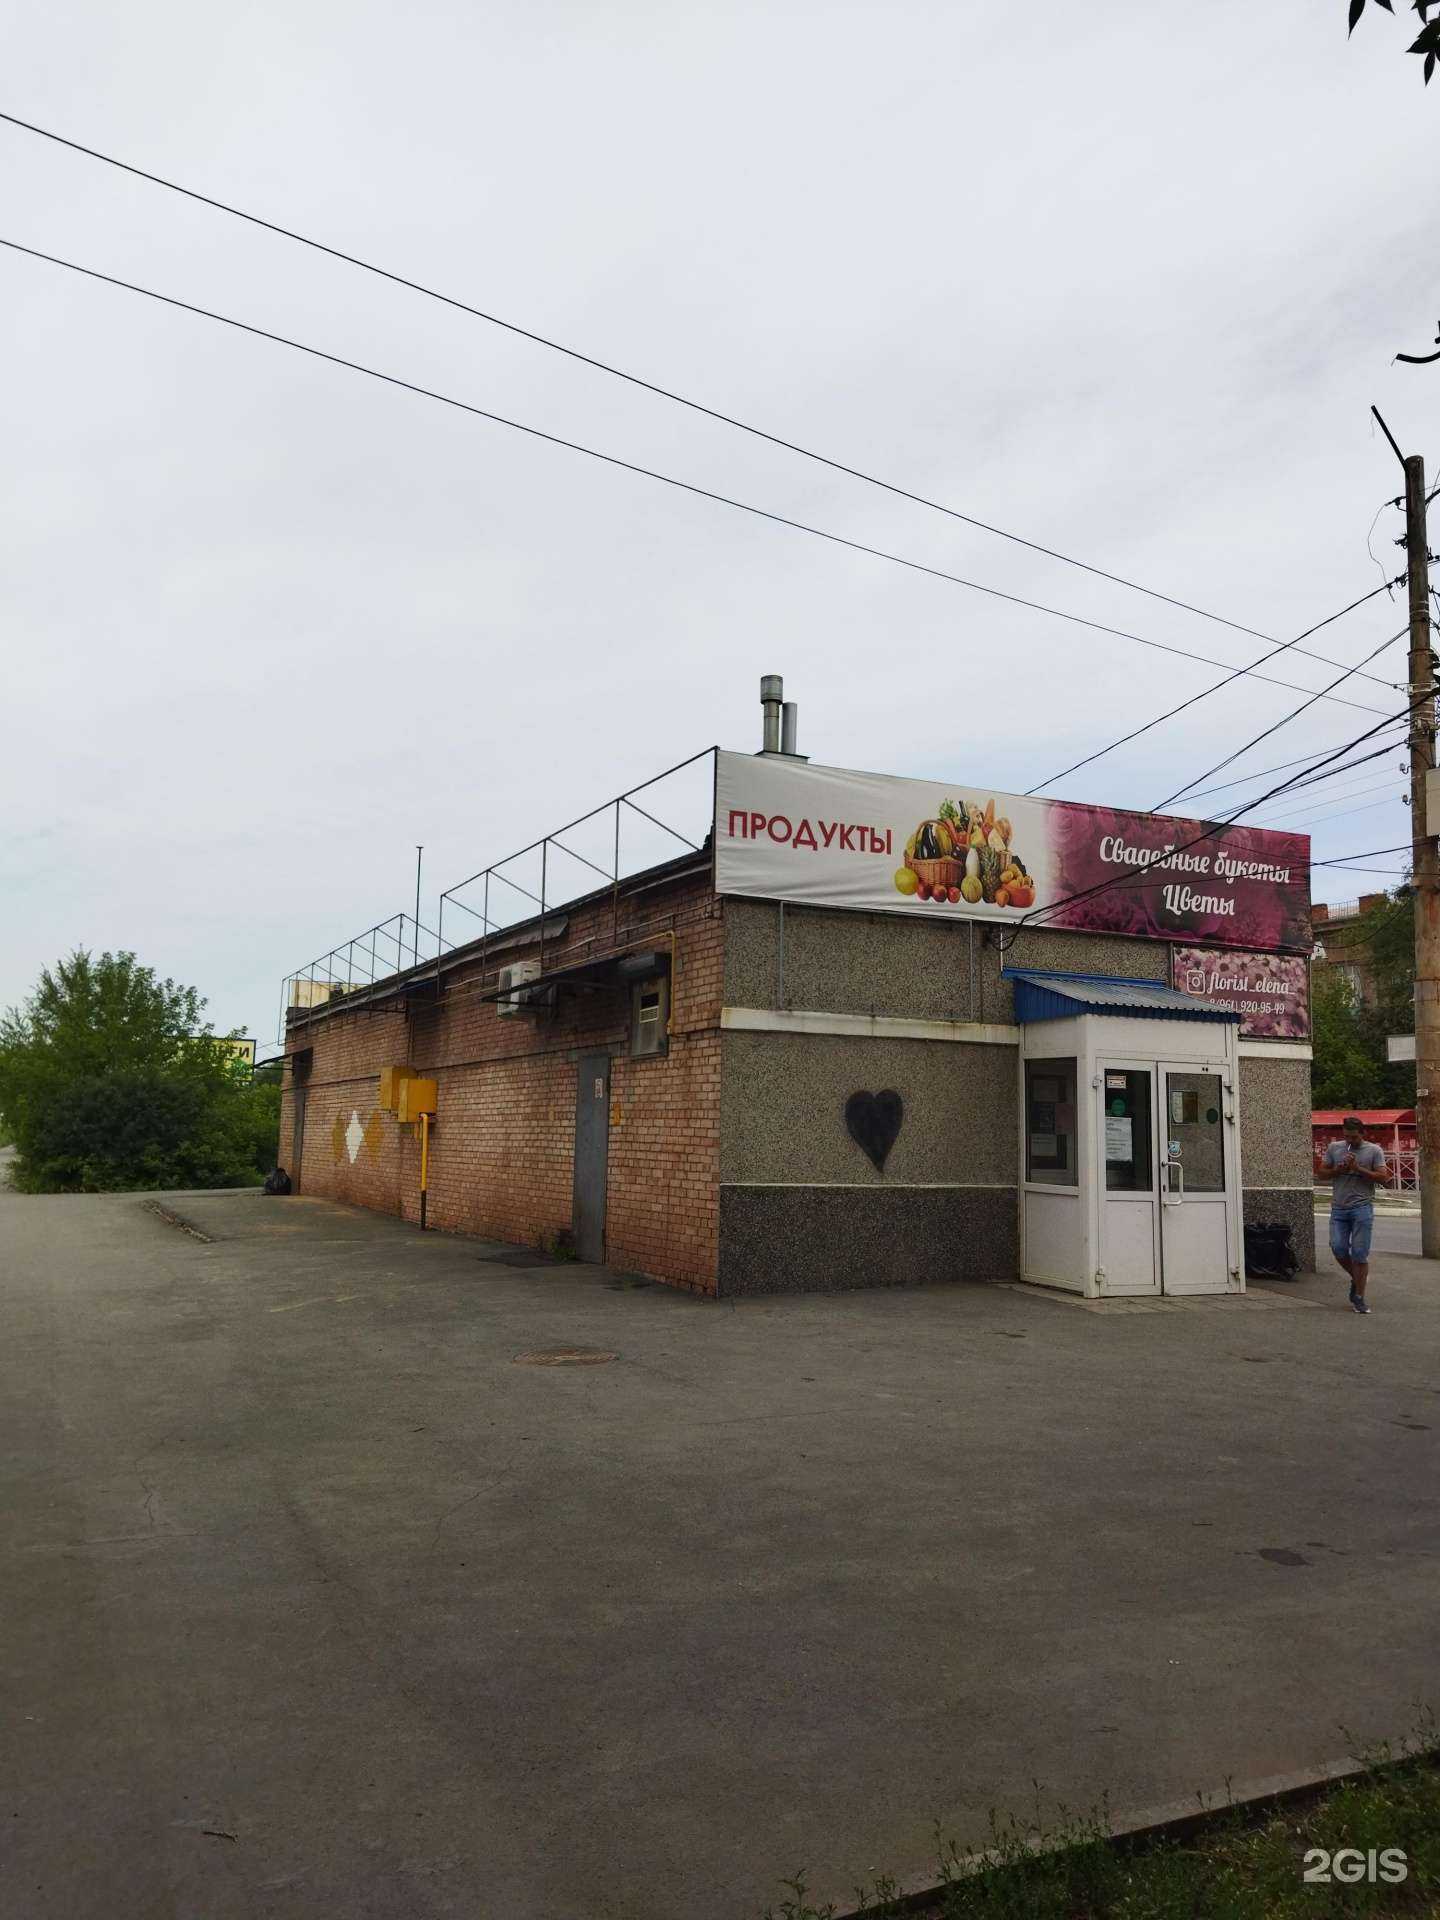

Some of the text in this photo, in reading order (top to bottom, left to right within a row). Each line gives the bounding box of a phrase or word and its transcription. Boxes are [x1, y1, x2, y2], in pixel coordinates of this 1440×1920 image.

[728, 810, 892, 855] ПРОДУКТЫ
[1100, 836, 1290, 884] Свадебные букеты
[1162, 884, 1236, 916] Цветы
